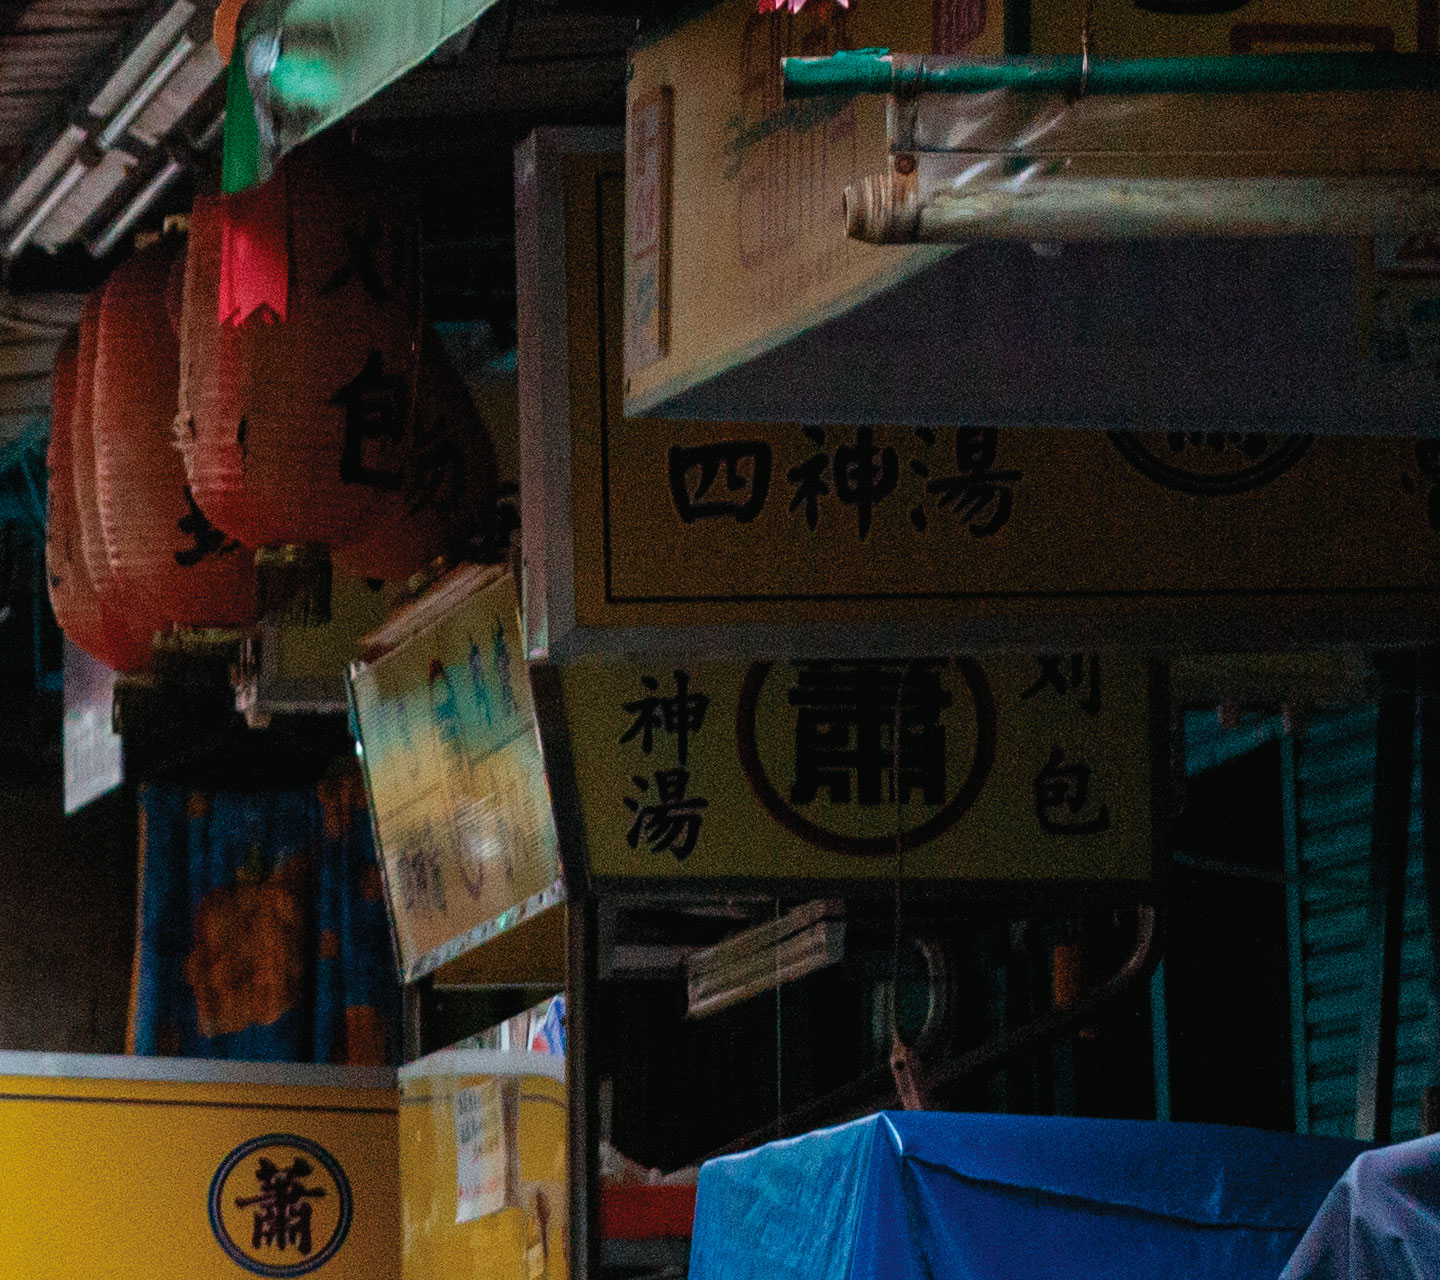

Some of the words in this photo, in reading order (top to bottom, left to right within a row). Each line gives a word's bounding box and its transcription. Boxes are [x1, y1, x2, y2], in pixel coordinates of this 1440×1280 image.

[667, 424, 1023, 541] 四神湯
[617, 670, 712, 863] 神湯
